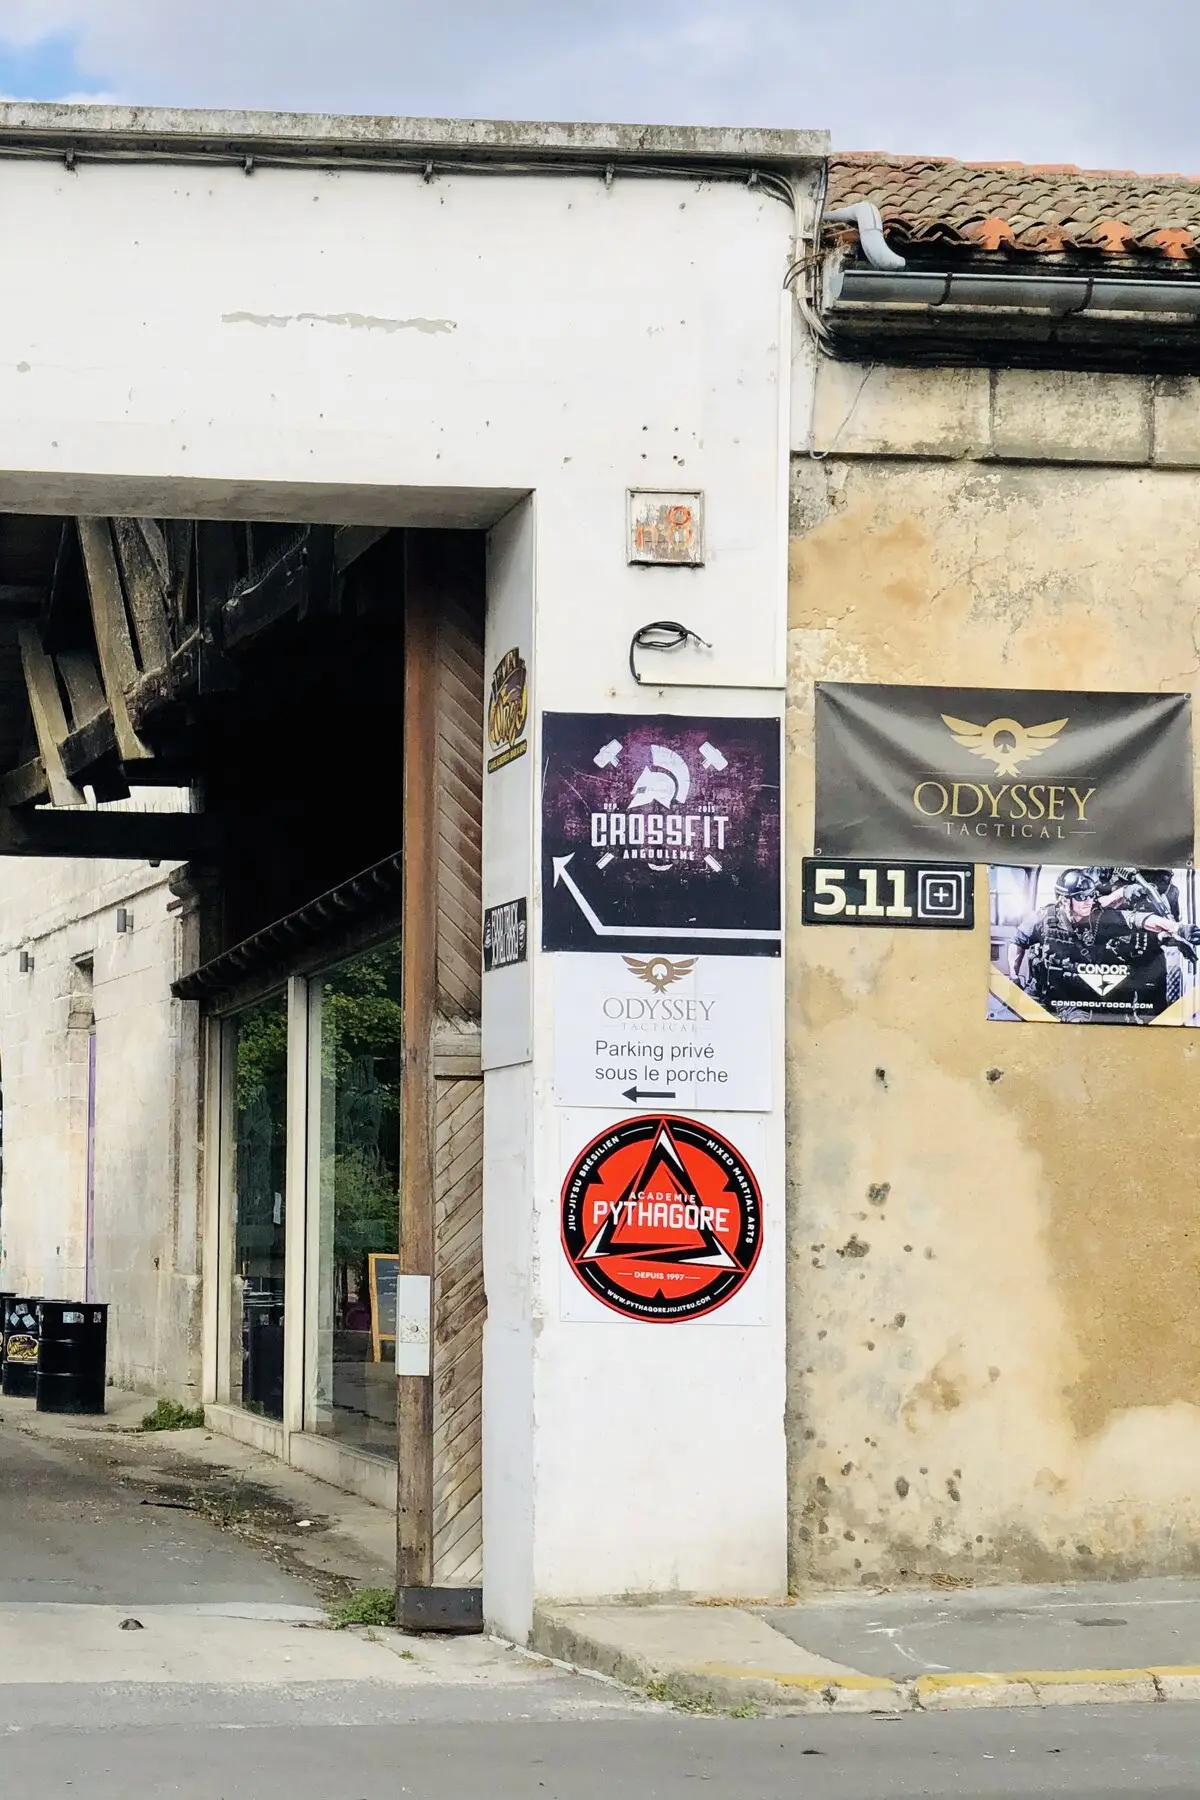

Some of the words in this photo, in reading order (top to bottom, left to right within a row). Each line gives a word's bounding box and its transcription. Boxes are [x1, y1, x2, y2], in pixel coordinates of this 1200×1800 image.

[912, 781, 1097, 821] ODYSSEY
[591, 812, 729, 850] CROSSFIT
[942, 822, 1067, 840] TACTICAL
[622, 848, 695, 861] ANGOULEME
[813, 868, 914, 918] 5.11
[1076, 963, 1130, 976] CONDOR
[602, 997, 717, 1022] ODYSSEY
[1050, 1000, 1154, 1010] CONDOROUTDOOR.COM
[595, 1039, 664, 1062] Parking
[670, 1043, 715, 1062] privé
[595, 1067, 638, 1081] sous
[644, 1065, 660, 1081] le
[666, 1067, 728, 1086] porche
[568, 1178, 583, 1232] JIU-JITSU
[578, 1135, 620, 1177] BRÉSILIEN
[706, 1139, 735, 1166] MIXED
[732, 1167, 755, 1213] MARTIAL
[745, 1216, 756, 1245] ARTS
[628, 1191, 697, 1204] ACADEMIE
[592, 1200, 731, 1233] PYTHAGORE
[634, 1271, 665, 1280] DEPUIS
[666, 1273, 685, 1281] 1997
[606, 1289, 712, 1314] WWW.PYTHAGOREJIUJITSU.COM
